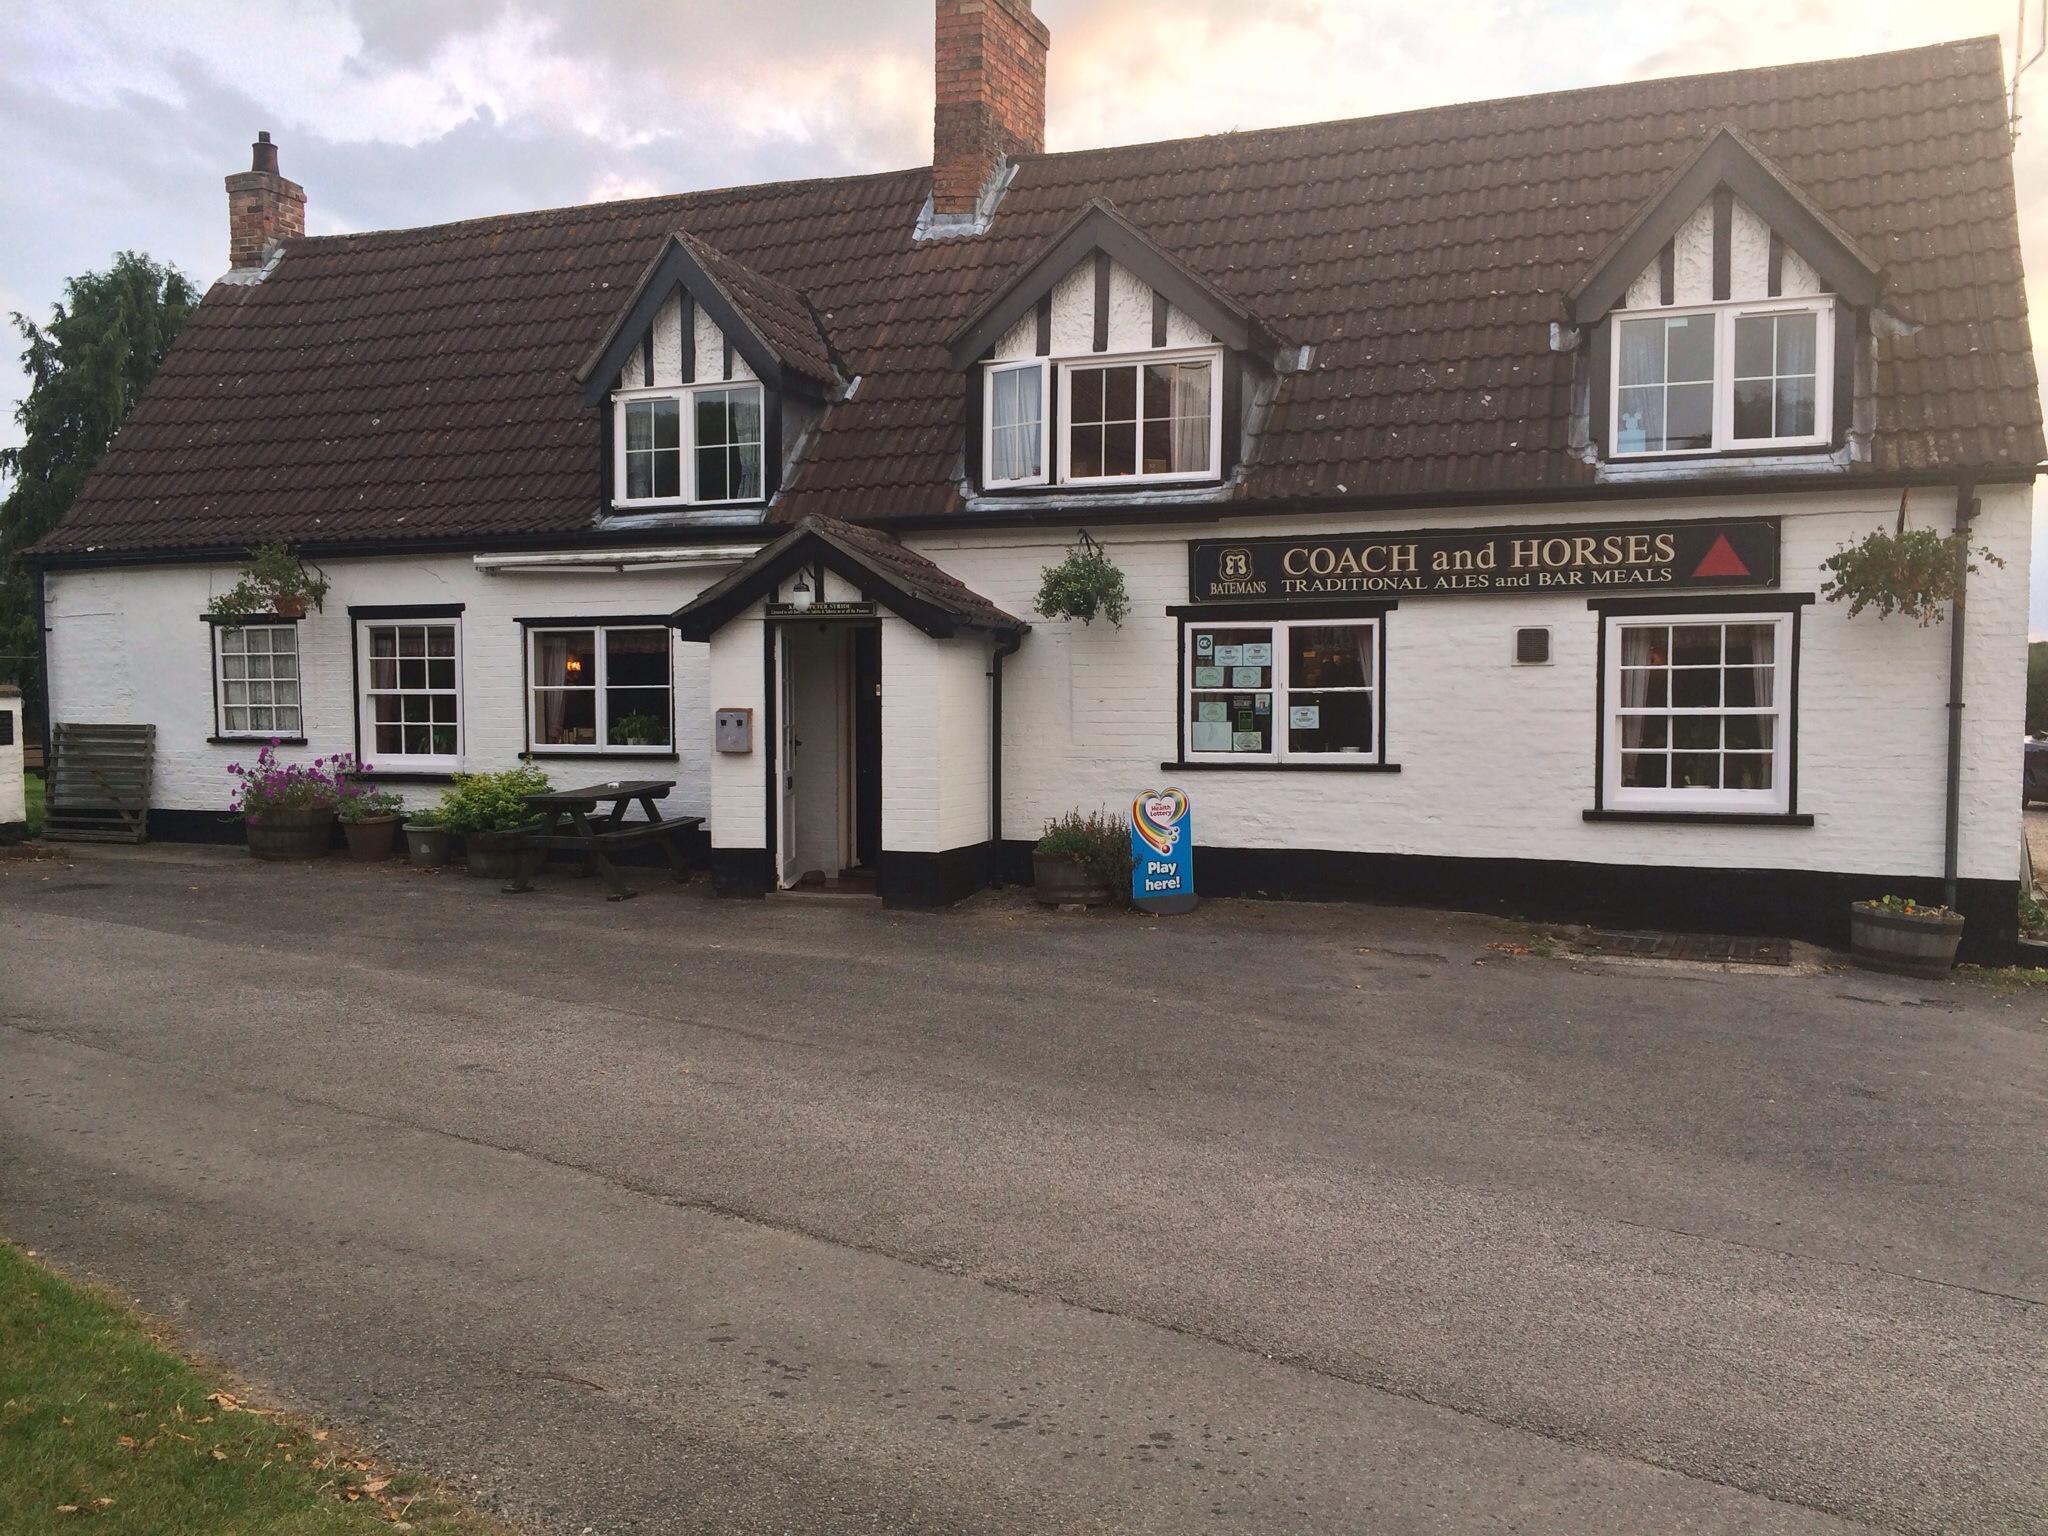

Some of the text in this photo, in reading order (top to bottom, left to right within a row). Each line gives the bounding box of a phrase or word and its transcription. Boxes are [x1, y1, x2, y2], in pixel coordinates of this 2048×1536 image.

[1283, 545, 1418, 576] COACH
[1432, 542, 1497, 570] and
[1511, 533, 1676, 568] HORSES
[1210, 581, 1267, 595] BATEMANS
[1282, 568, 1672, 593] TRADITIONAL ALES and BAR MEALS
[1147, 861, 1177, 876] Play
[1145, 876, 1181, 892] here!
